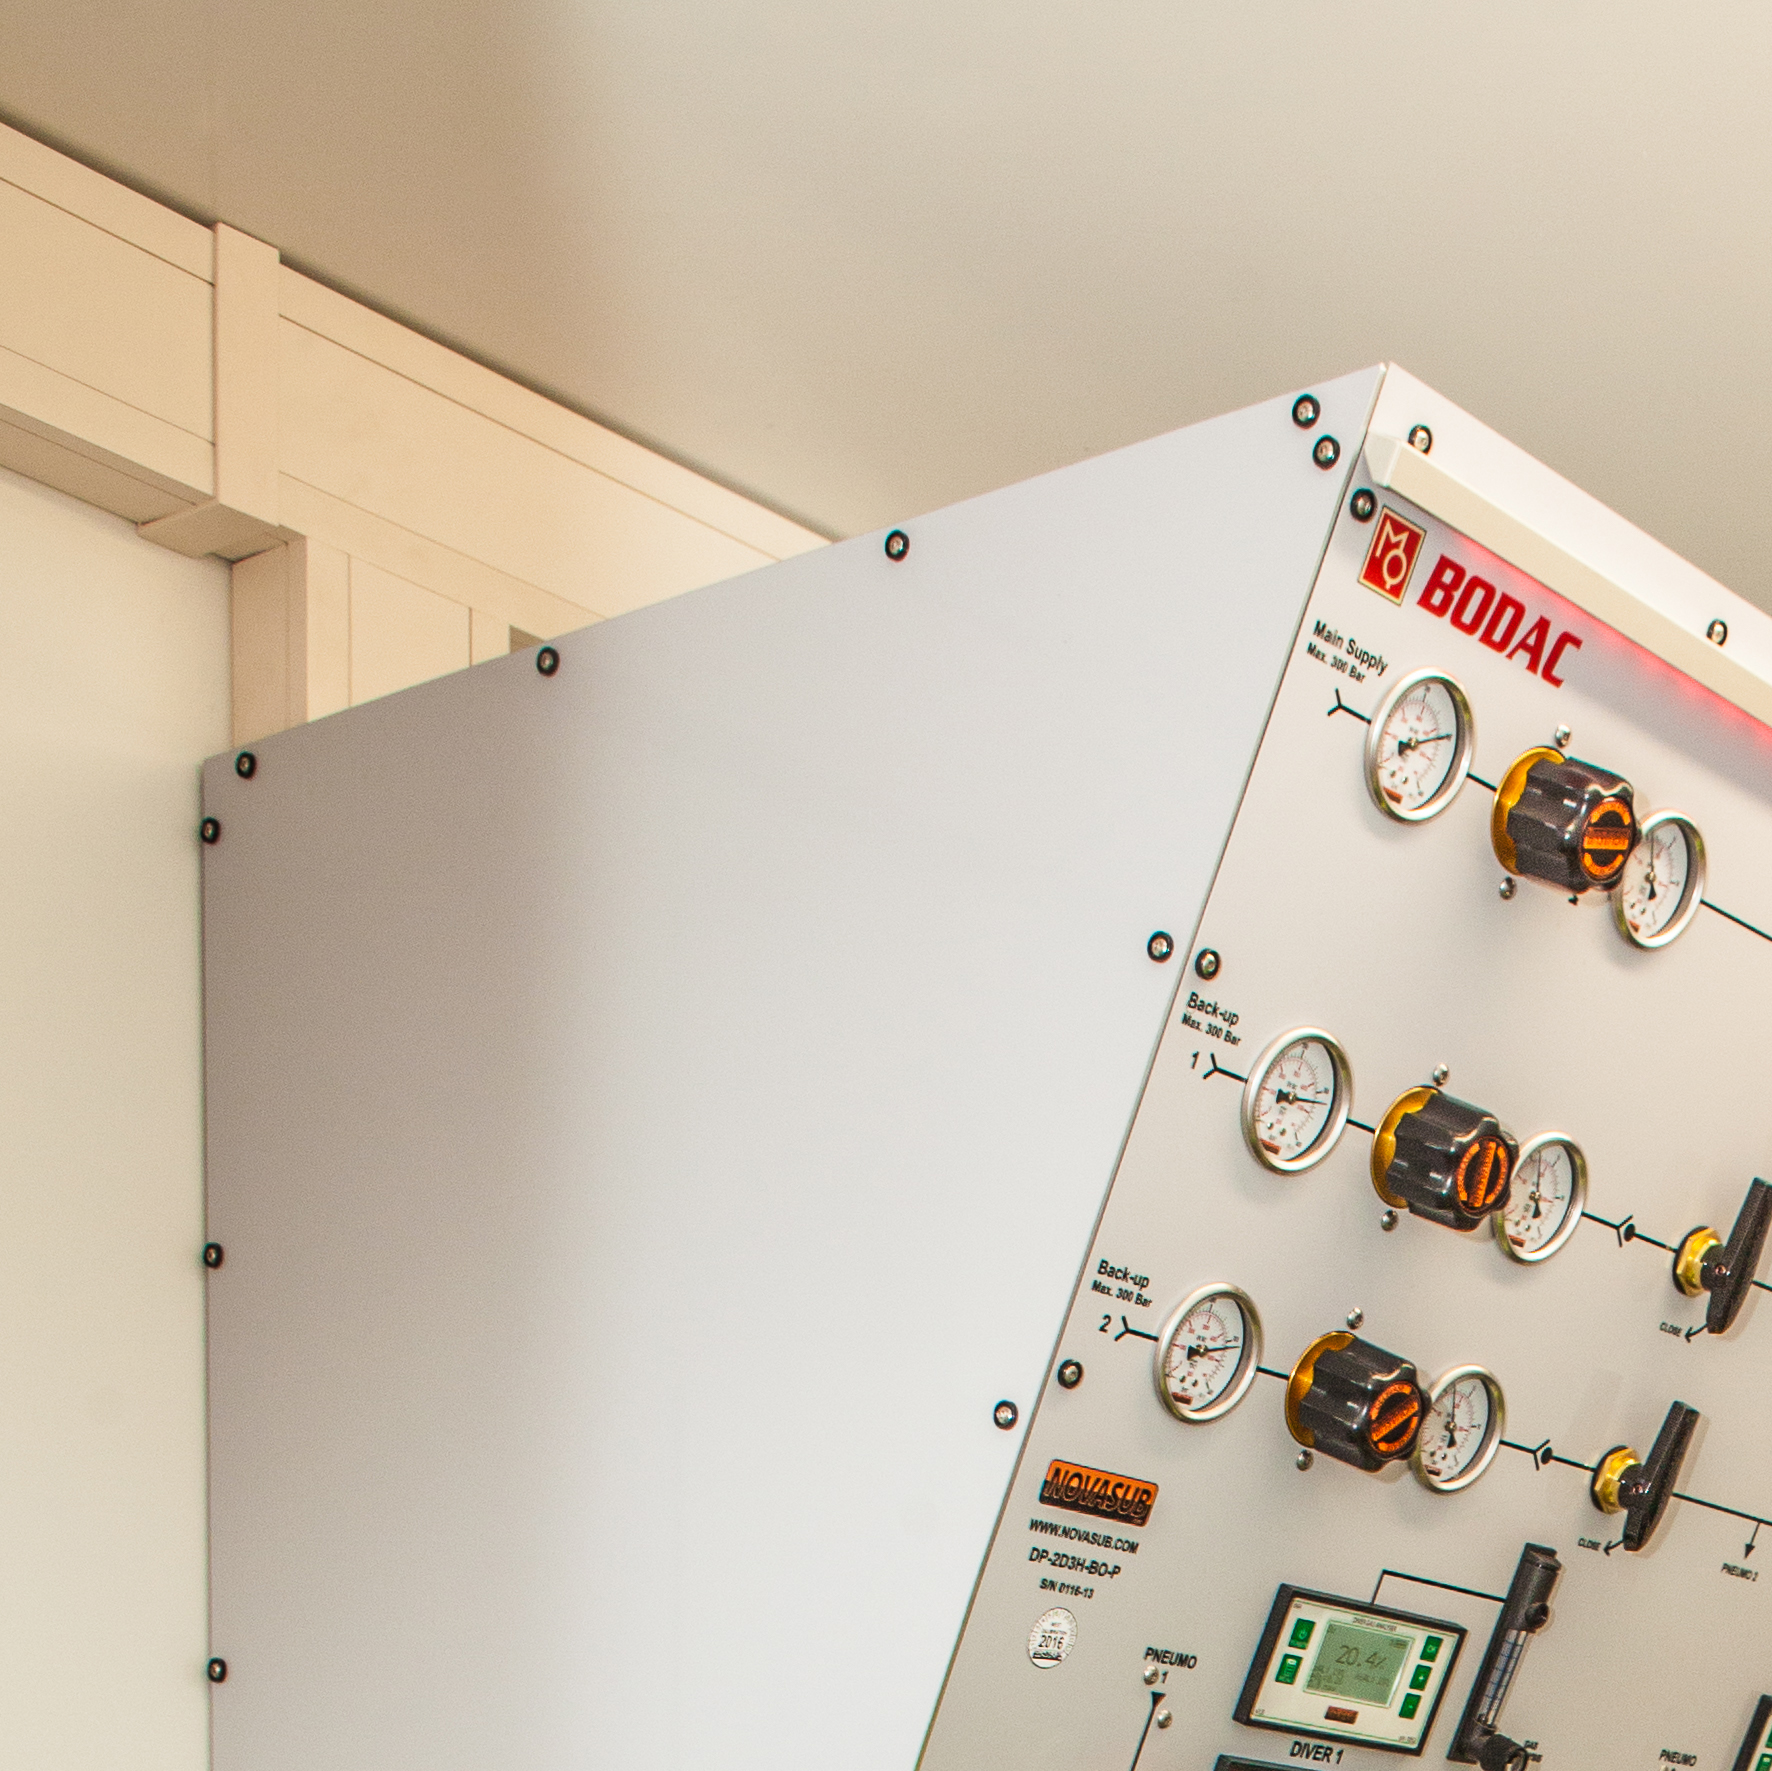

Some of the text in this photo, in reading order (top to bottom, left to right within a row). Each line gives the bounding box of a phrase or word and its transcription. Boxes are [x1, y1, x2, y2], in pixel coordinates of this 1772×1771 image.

[1417, 554, 1583, 688] BODAC
[1312, 619, 1389, 678] Main Supply
[1330, 654, 1349, 675] 300
[1348, 663, 1366, 685] Bar
[1187, 990, 1240, 1028] Back-up
[1205, 1022, 1223, 1040] 300
[1223, 1029, 1242, 1048] Bar
[1191, 1050, 1200, 1070] 1
[1097, 1258, 1151, 1291] Back-up
[1091, 1279, 1153, 1309] Max. 300 Bar
[1098, 1314, 1112, 1334] 2
[1659, 1320, 1683, 1339] CLOSE
[1044, 1467, 1152, 1518] NOVASUB
[1028, 1517, 1140, 1556] WWW.NOVASUB.COM
[1037, 1633, 1066, 1650] 2016
[1144, 1646, 1198, 1684] PNEUMO 1
[1289, 1740, 1345, 1765] DIVER 1
[1658, 1748, 1698, 1767] PNEUMO
